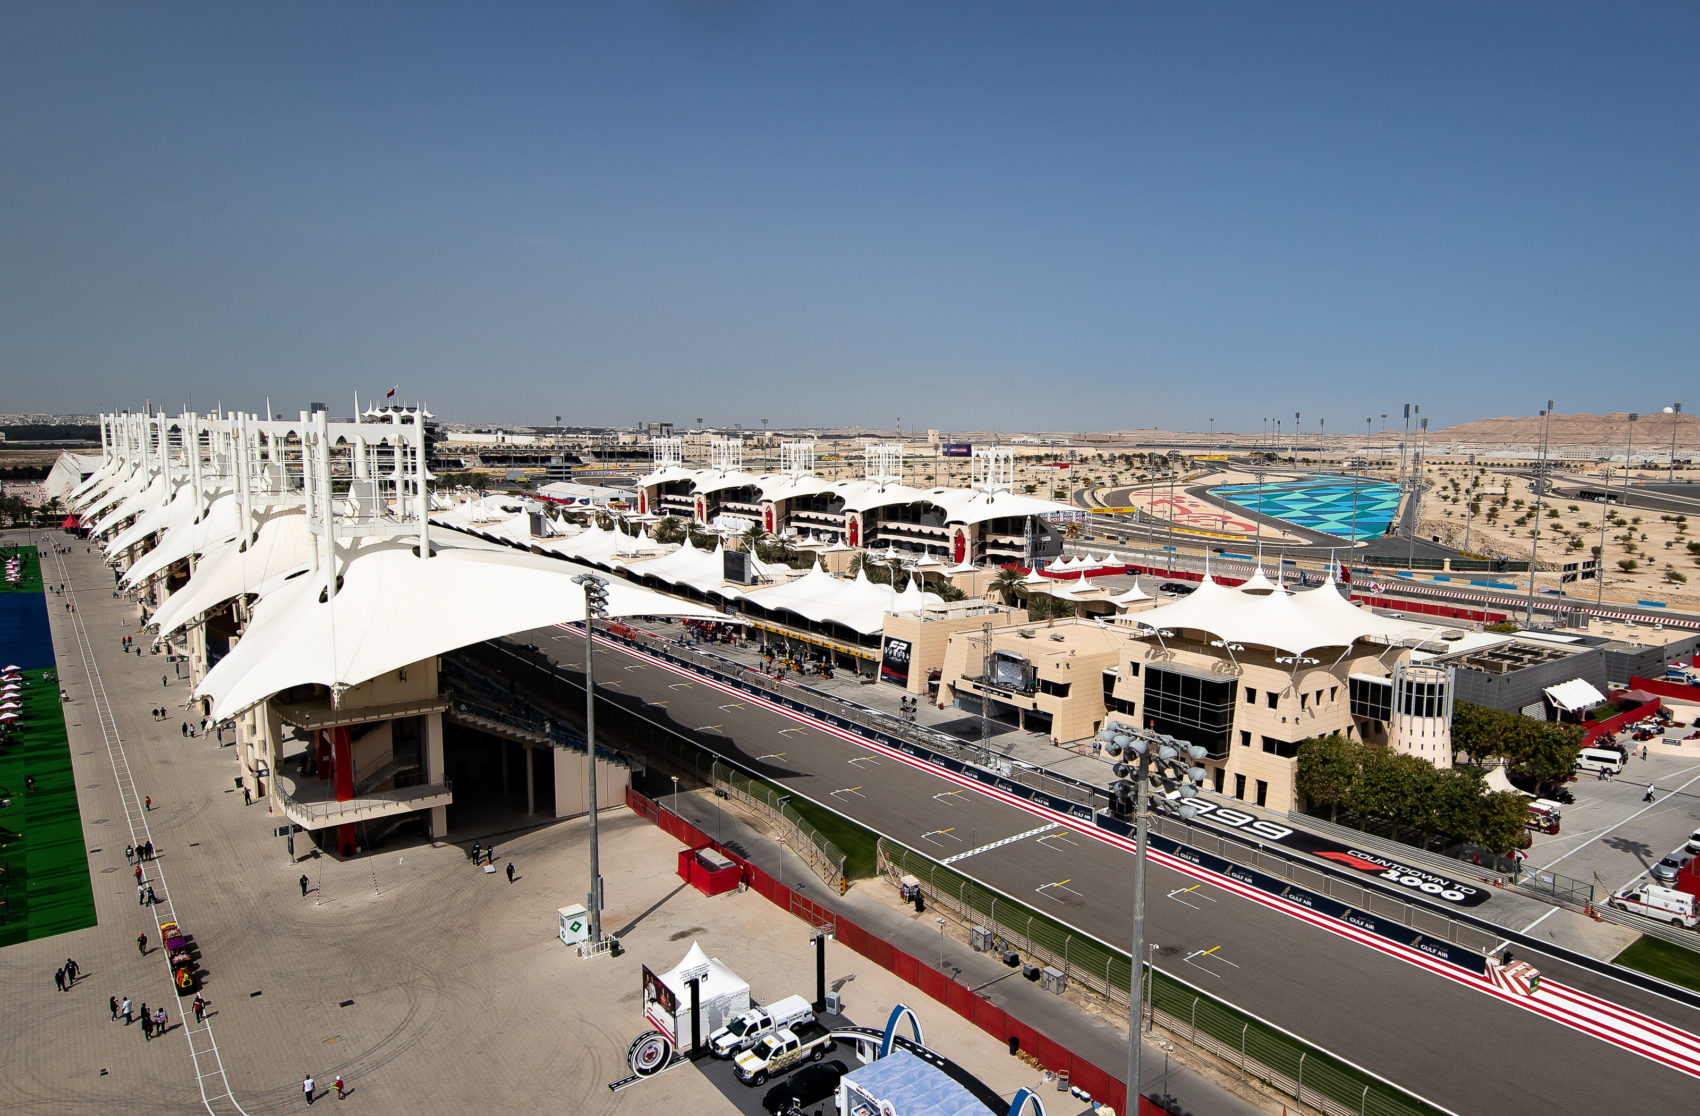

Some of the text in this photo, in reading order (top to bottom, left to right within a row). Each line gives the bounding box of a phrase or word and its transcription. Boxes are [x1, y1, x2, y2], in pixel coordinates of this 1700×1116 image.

[1073, 811, 1084, 819] GULF
[1180, 853, 1191, 861] GULF
[1191, 856, 1200, 864] AIR
[1231, 872, 1244, 881] GULF
[1244, 876, 1253, 884] AIR
[1346, 850, 1477, 895] COUNTDOWN TO
[1379, 868, 1466, 901] 1000
[1289, 894, 1303, 903] GULF
[1302, 899, 1312, 907] AIR
[1349, 917, 1364, 926] GULF
[1364, 922, 1375, 930] AIR
[1420, 944, 1437, 954] GULF
[1437, 950, 1449, 959] AIR
